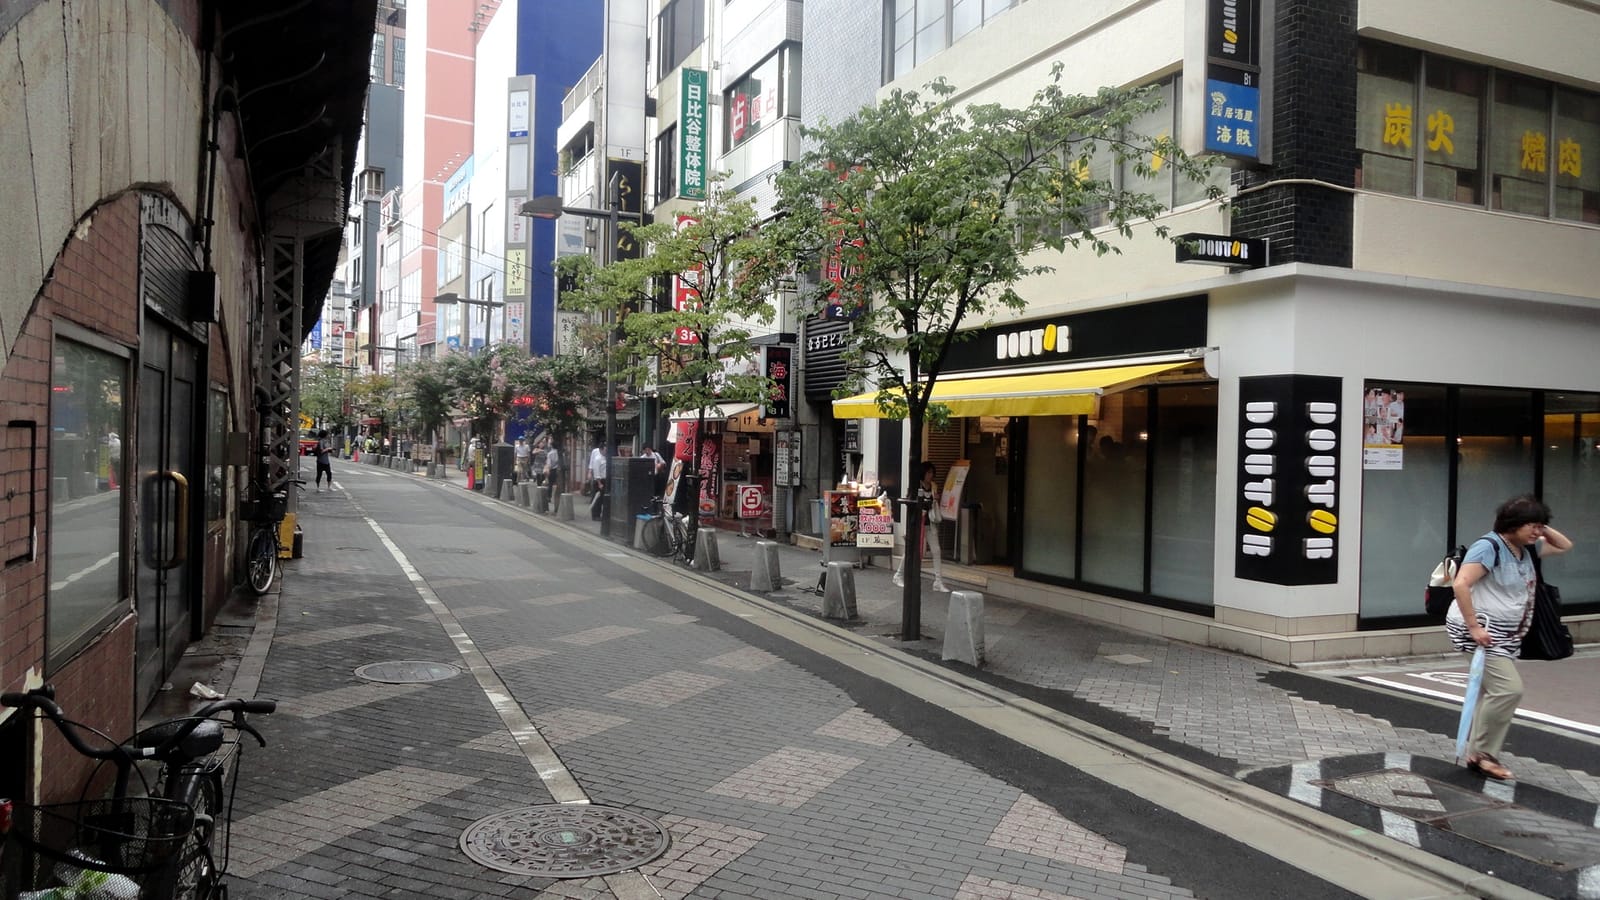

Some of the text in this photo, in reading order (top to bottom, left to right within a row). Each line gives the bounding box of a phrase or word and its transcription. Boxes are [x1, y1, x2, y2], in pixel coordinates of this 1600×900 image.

[1244, 73, 1252, 86] B1
[1224, 106, 1254, 122] 居酒屋
[684, 84, 703, 187] 日比谷整体院
[1216, 125, 1253, 147] 海賊
[1382, 101, 1582, 178] 炭火 焼肉
[620, 148, 632, 158] 1F
[1198, 238, 1249, 259] DOUTOR
[996, 324, 1072, 360] DOUTOR
[1243, 402, 1277, 557] DOUTOR
[1303, 402, 1337, 559] DOUTOR
[745, 490, 759, 506] 占
